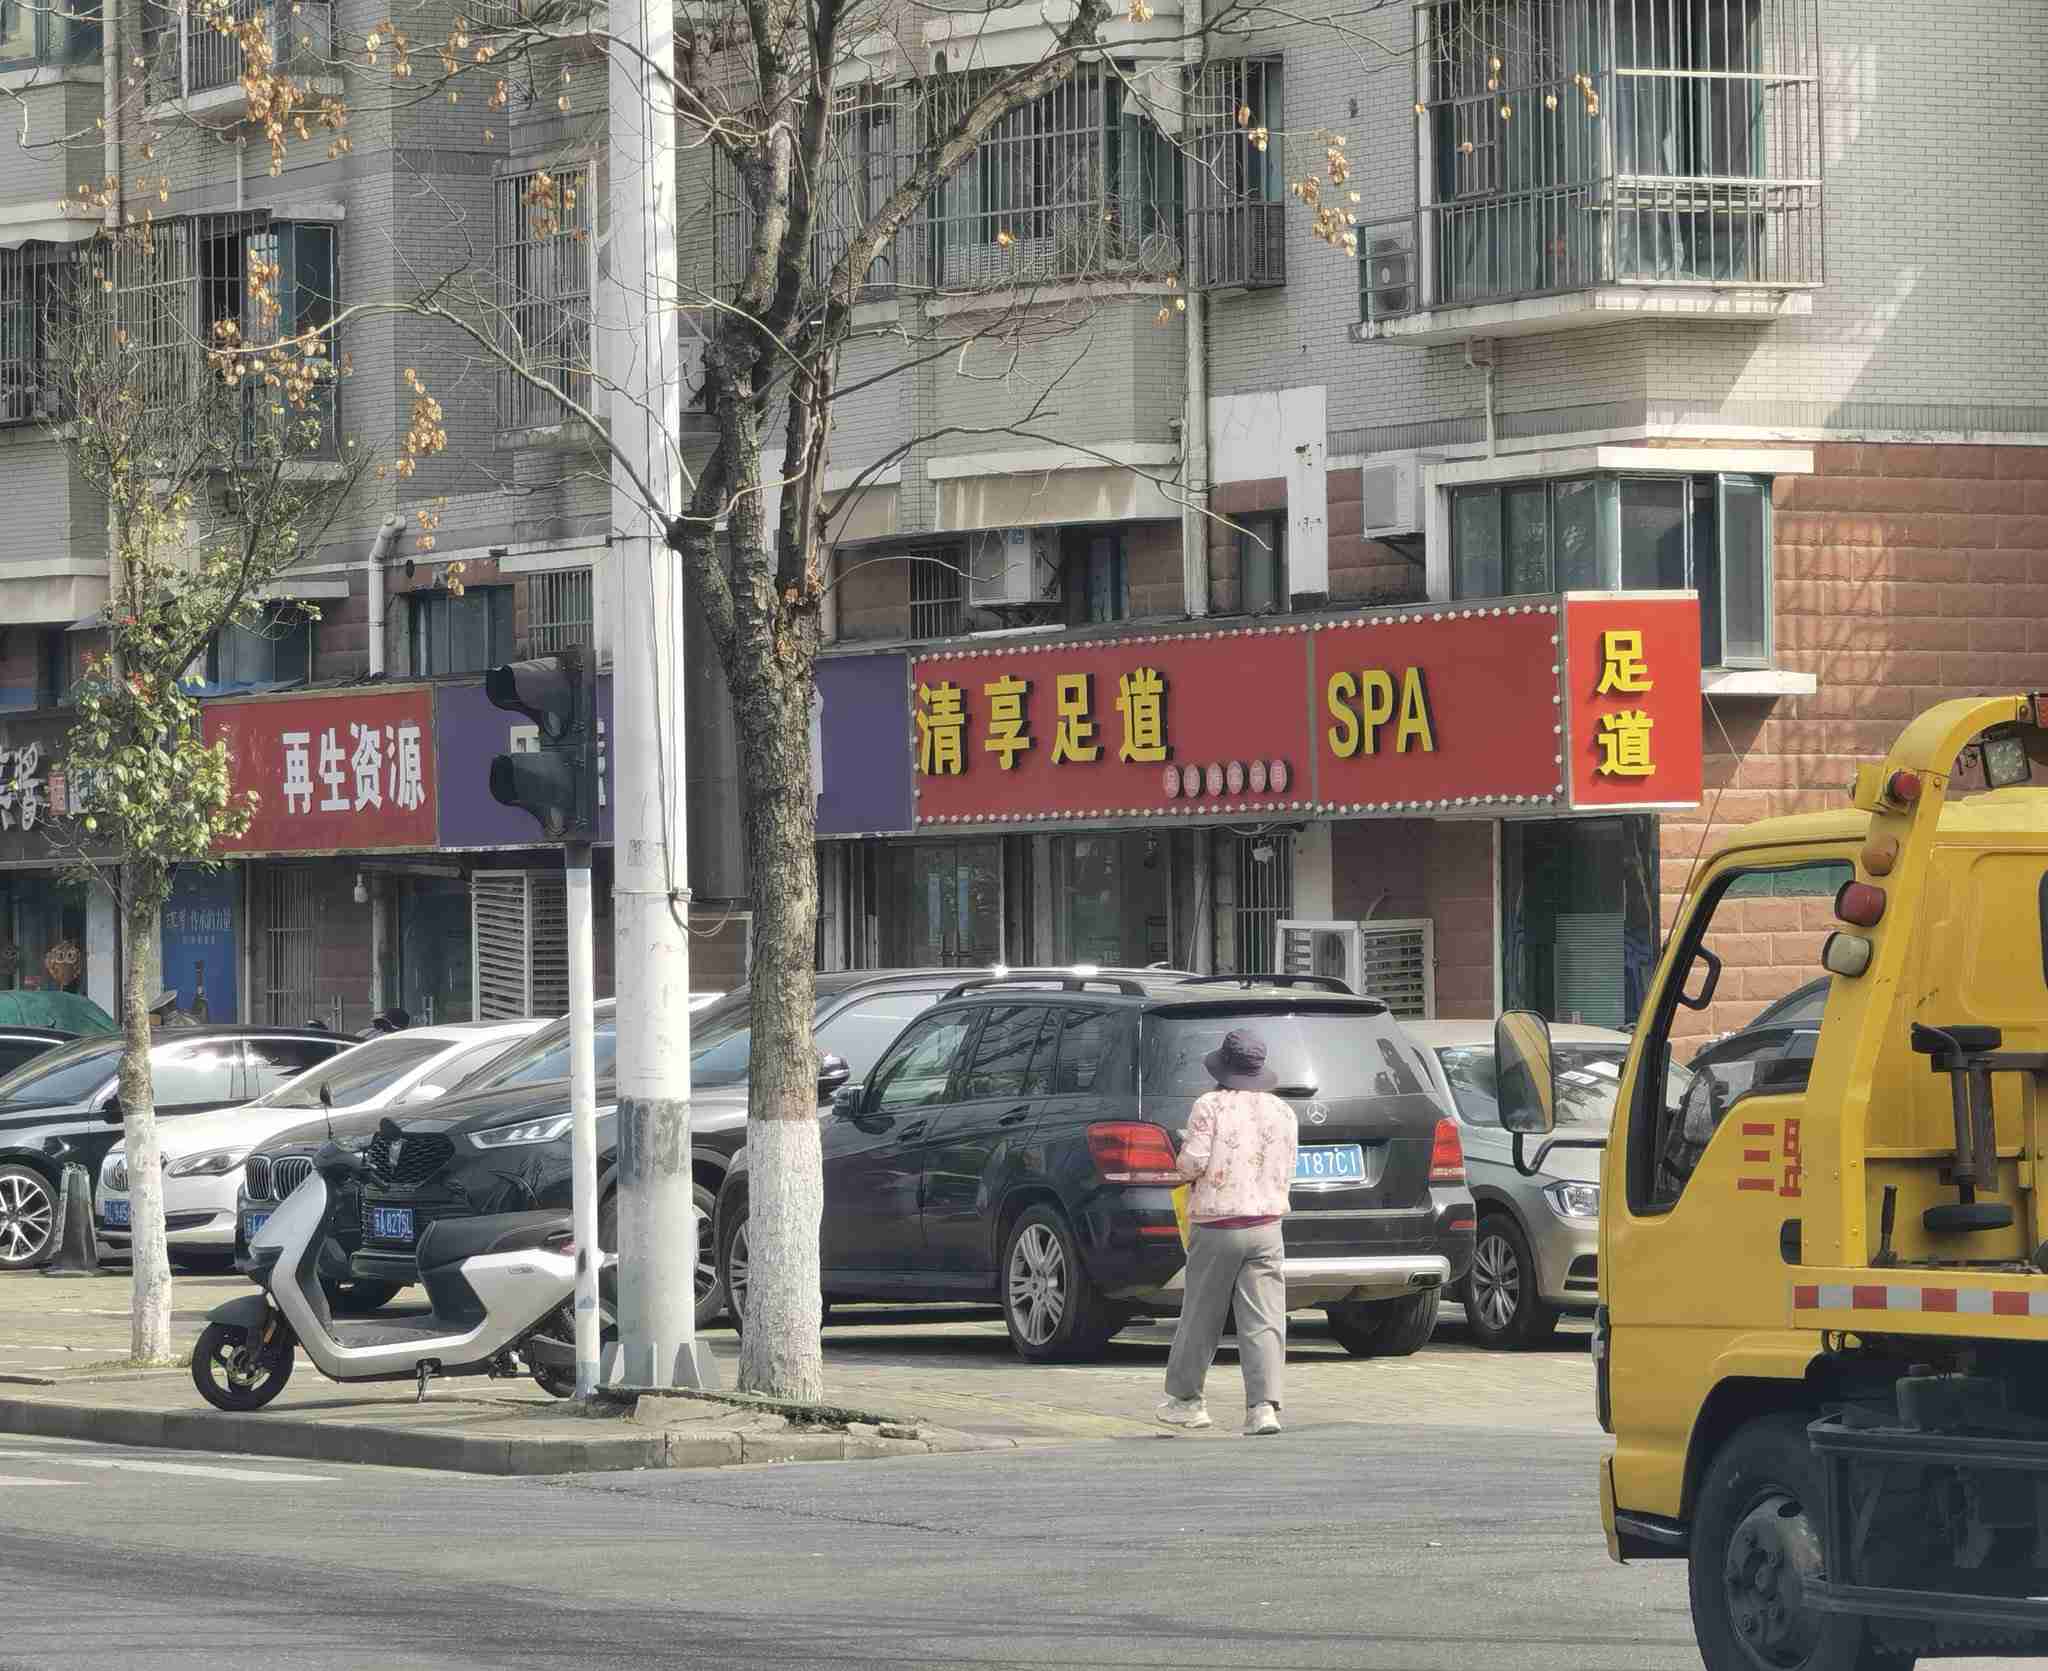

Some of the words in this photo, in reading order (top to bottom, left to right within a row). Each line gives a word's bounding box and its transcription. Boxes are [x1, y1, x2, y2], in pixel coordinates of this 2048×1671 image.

[916, 668, 1168, 775] 清享足道
[1327, 667, 1434, 758] SPA
[1599, 630, 1657, 777] 足道
[282, 721, 426, 815] 再生资源
